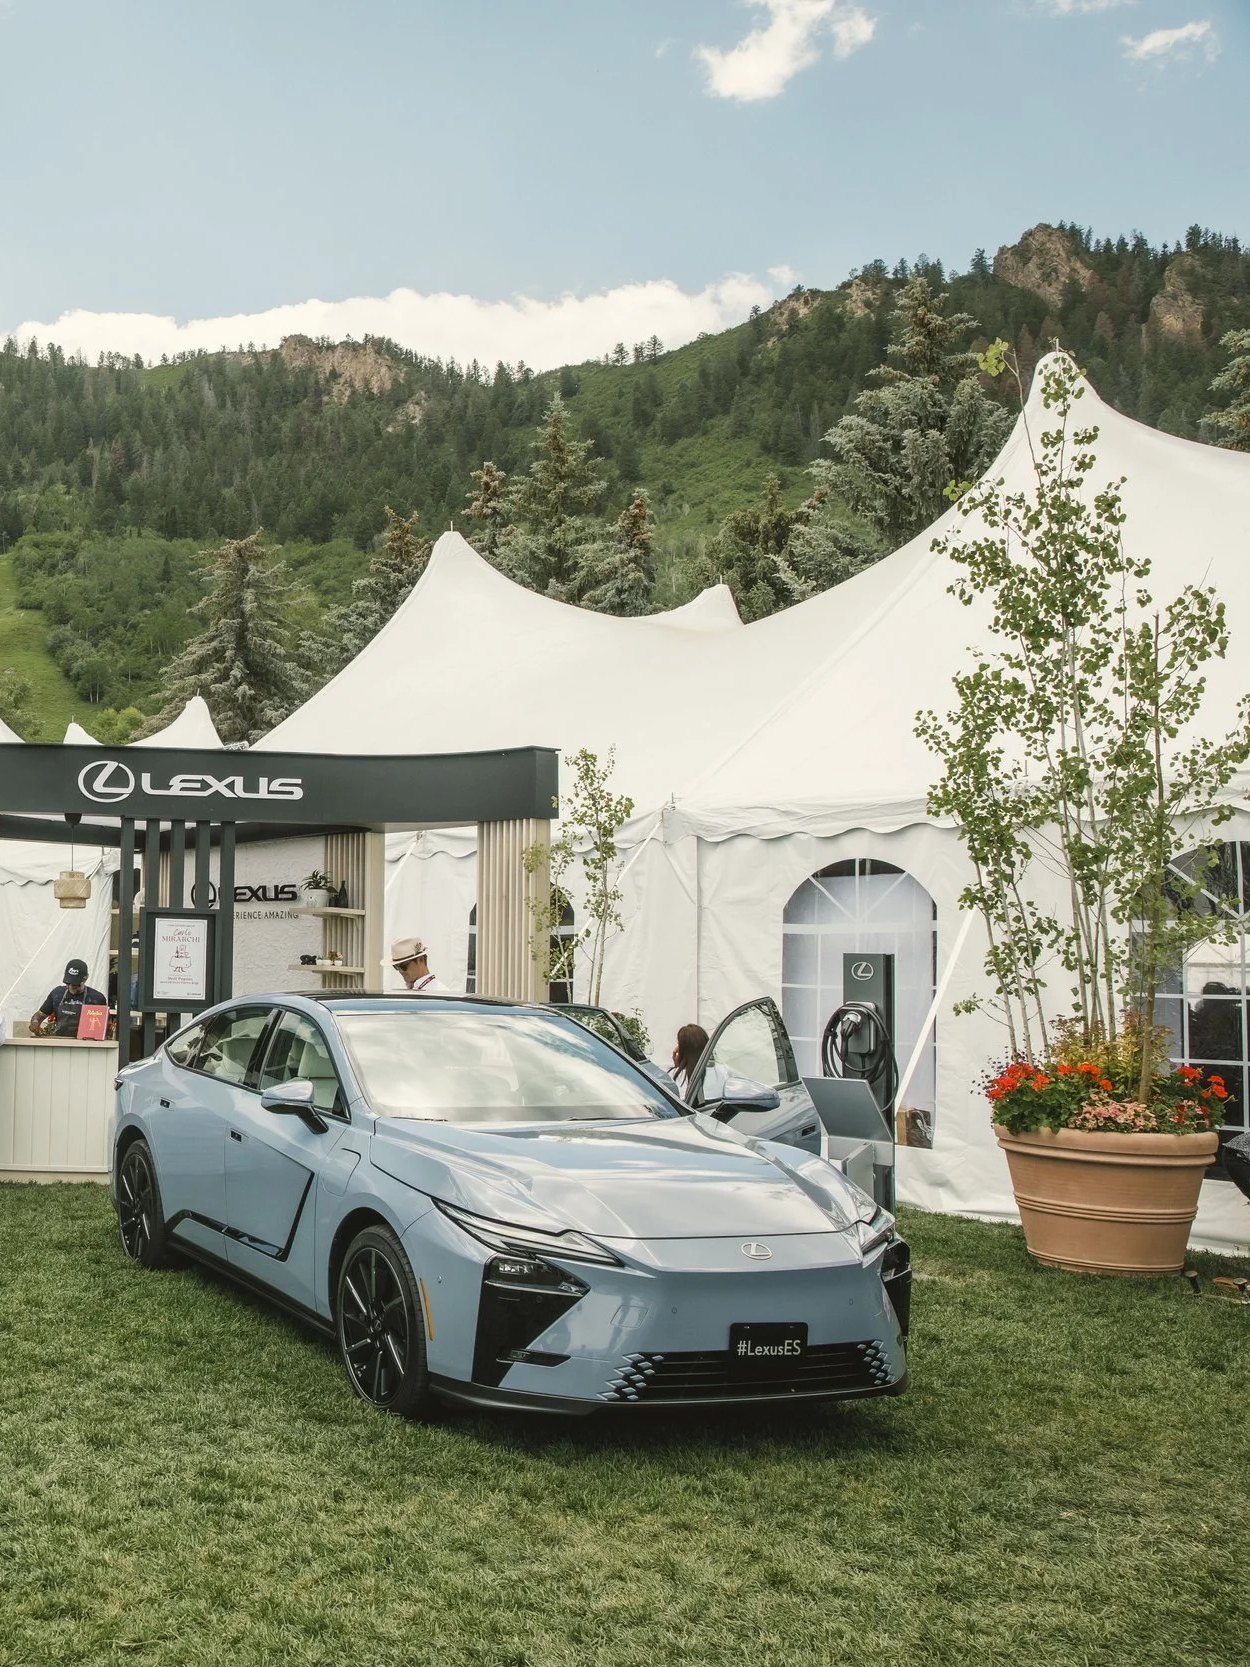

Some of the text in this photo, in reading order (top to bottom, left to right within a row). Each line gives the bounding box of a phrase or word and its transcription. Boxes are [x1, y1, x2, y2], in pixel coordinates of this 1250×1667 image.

[141, 772, 304, 800] LEXUS
[218, 884, 298, 902] EXUS
[737, 1340, 801, 1356] #LexusES
